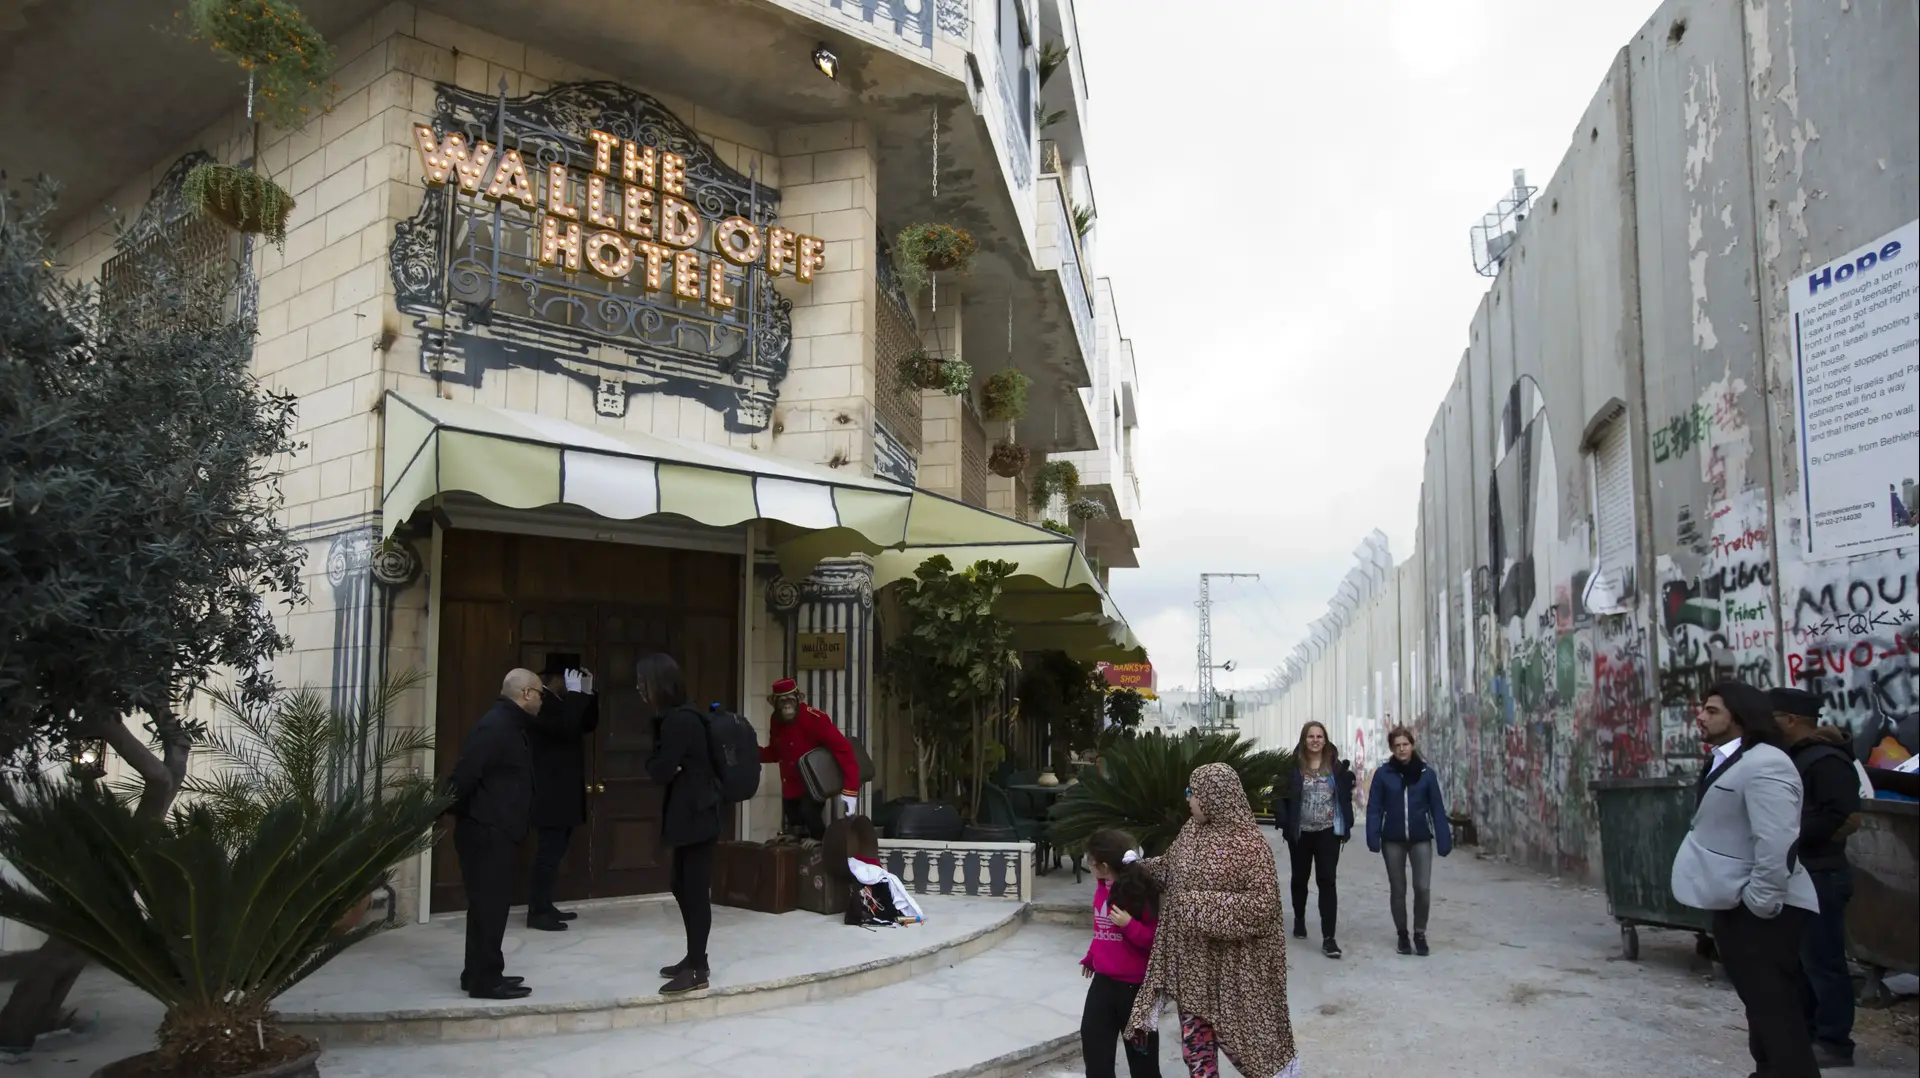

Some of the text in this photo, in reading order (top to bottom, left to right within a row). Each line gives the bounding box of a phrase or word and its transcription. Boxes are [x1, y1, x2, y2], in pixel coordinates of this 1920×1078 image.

[588, 128, 687, 198] THE
[413, 122, 825, 284] WALLED OFF
[538, 214, 735, 310] HOTEL
[1808, 240, 1902, 297] Hope
[1818, 295, 1838, 310] been
[1840, 281, 1872, 300] through
[1881, 271, 1893, 281] lot
[1894, 266, 1903, 275] in
[1803, 317, 1815, 328] life
[1816, 308, 1837, 323] while
[1839, 301, 1853, 313] still
[1808, 326, 1824, 338] saw
[1832, 314, 1852, 328] man
[1853, 307, 1868, 321] got
[1868, 298, 1888, 313] shot
[1889, 288, 1911, 305] right
[1804, 320, 1866, 352] front of me and
[1811, 348, 1827, 361] saw
[1829, 343, 1841, 353] an
[1843, 331, 1869, 348] Israeli
[1871, 316, 1911, 337] shooting
[1806, 374, 1820, 386] But
[1827, 363, 1851, 377] never
[1853, 348, 1890, 368] stopped
[1806, 362, 1819, 374] our
[1807, 385, 1822, 397] and
[1808, 402, 1844, 420] estinians
[1845, 396, 1860, 408] will
[1861, 391, 1877, 403] find
[1887, 382, 1907, 395] way
[1813, 394, 1833, 407] hope
[1835, 387, 1852, 399] that
[1853, 376, 1885, 393] Israelis
[1886, 368, 1904, 382] and
[1809, 422, 1818, 431] to
[1819, 418, 1833, 429] live
[1834, 415, 1843, 423] in
[1810, 431, 1826, 443] and
[1826, 426, 1842, 438] that
[1843, 420, 1866, 433] there
[1867, 415, 1879, 426] be
[1881, 412, 1894, 421] no
[1811, 456, 1823, 466] By
[1858, 441, 1879, 453] from
[1720, 561, 1772, 593] Libre
[1792, 571, 1919, 635] MOU
[1113, 663, 1151, 673] BANKSY'S
[1120, 675, 1141, 684] SHOP
